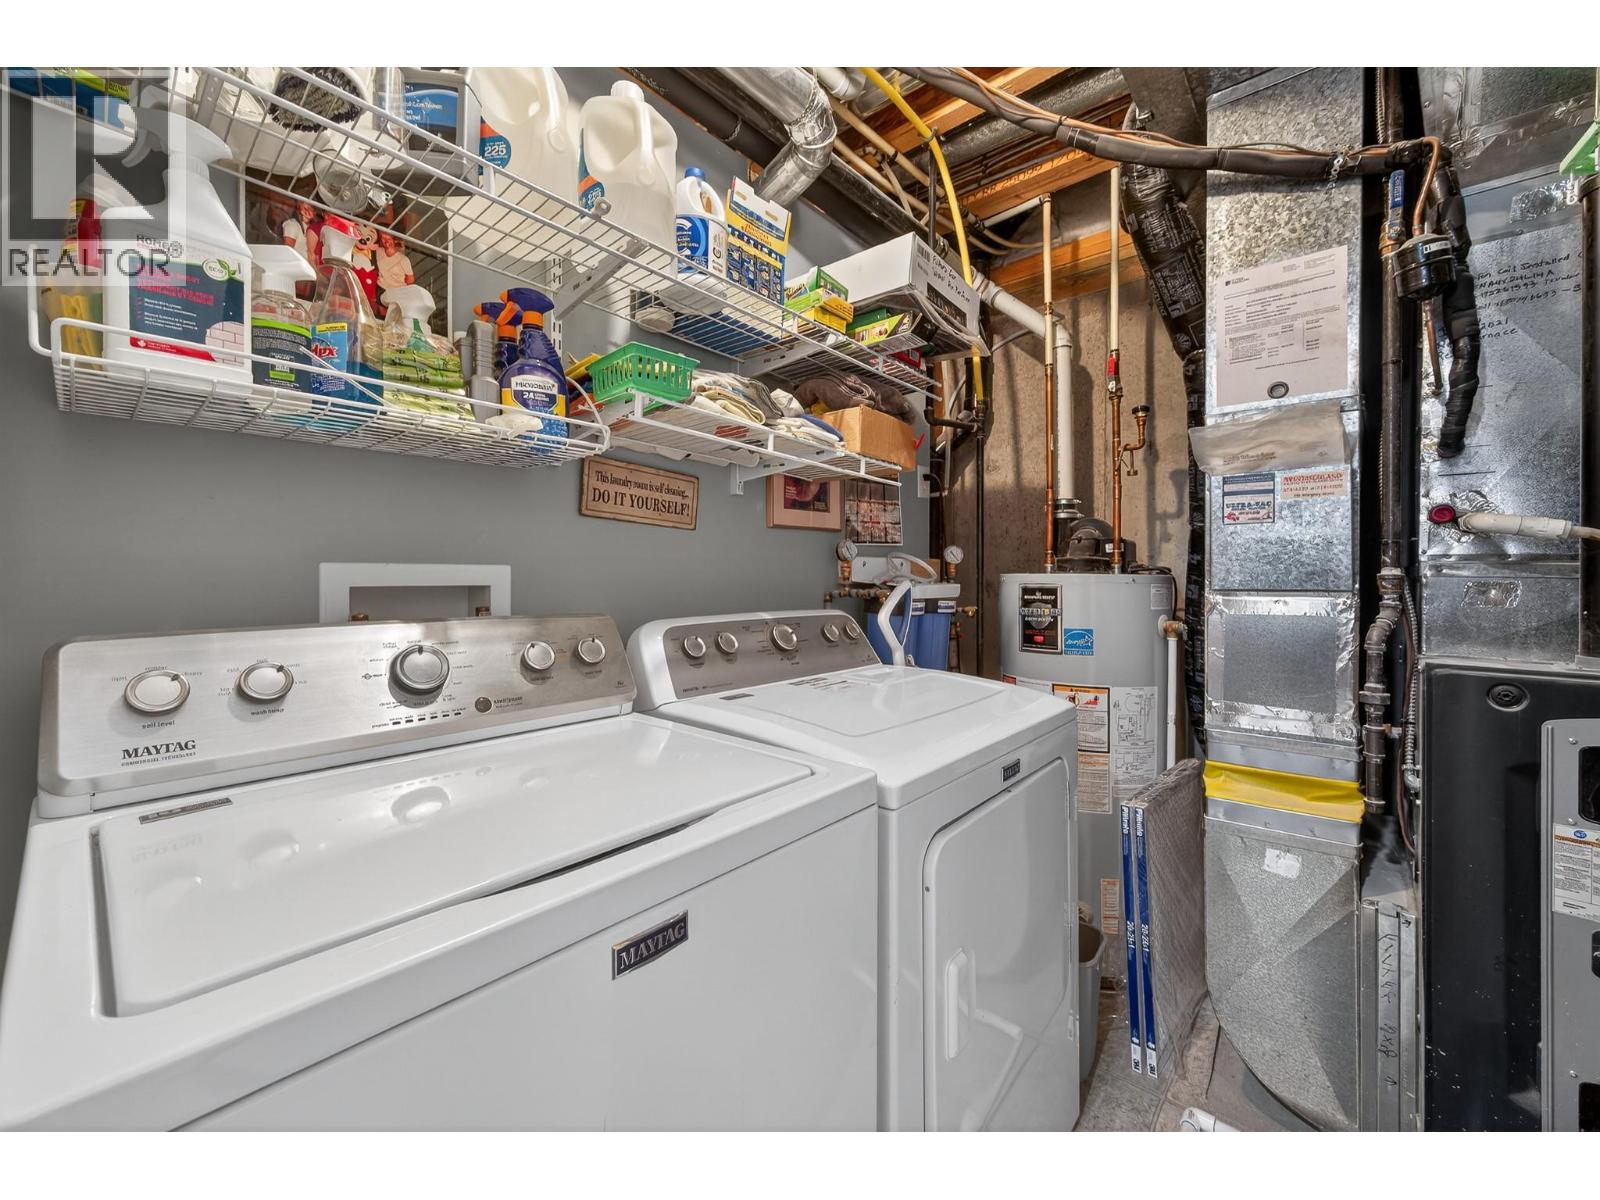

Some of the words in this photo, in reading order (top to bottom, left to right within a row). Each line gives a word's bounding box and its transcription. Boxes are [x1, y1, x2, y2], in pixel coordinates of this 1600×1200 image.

[485, 145, 506, 157] 225
[595, 471, 609, 484] This
[610, 473, 632, 490] laundry
[633, 481, 649, 491] room
[649, 481, 655, 492] is
[655, 482, 665, 494] self
[592, 487, 610, 504] DO
[614, 492, 627, 507] IT
[629, 494, 690, 517] YOURSELF!
[142, 721, 157, 729] soil
[122, 740, 196, 759] MAYTAG
[619, 922, 685, 969] MAYTAG
